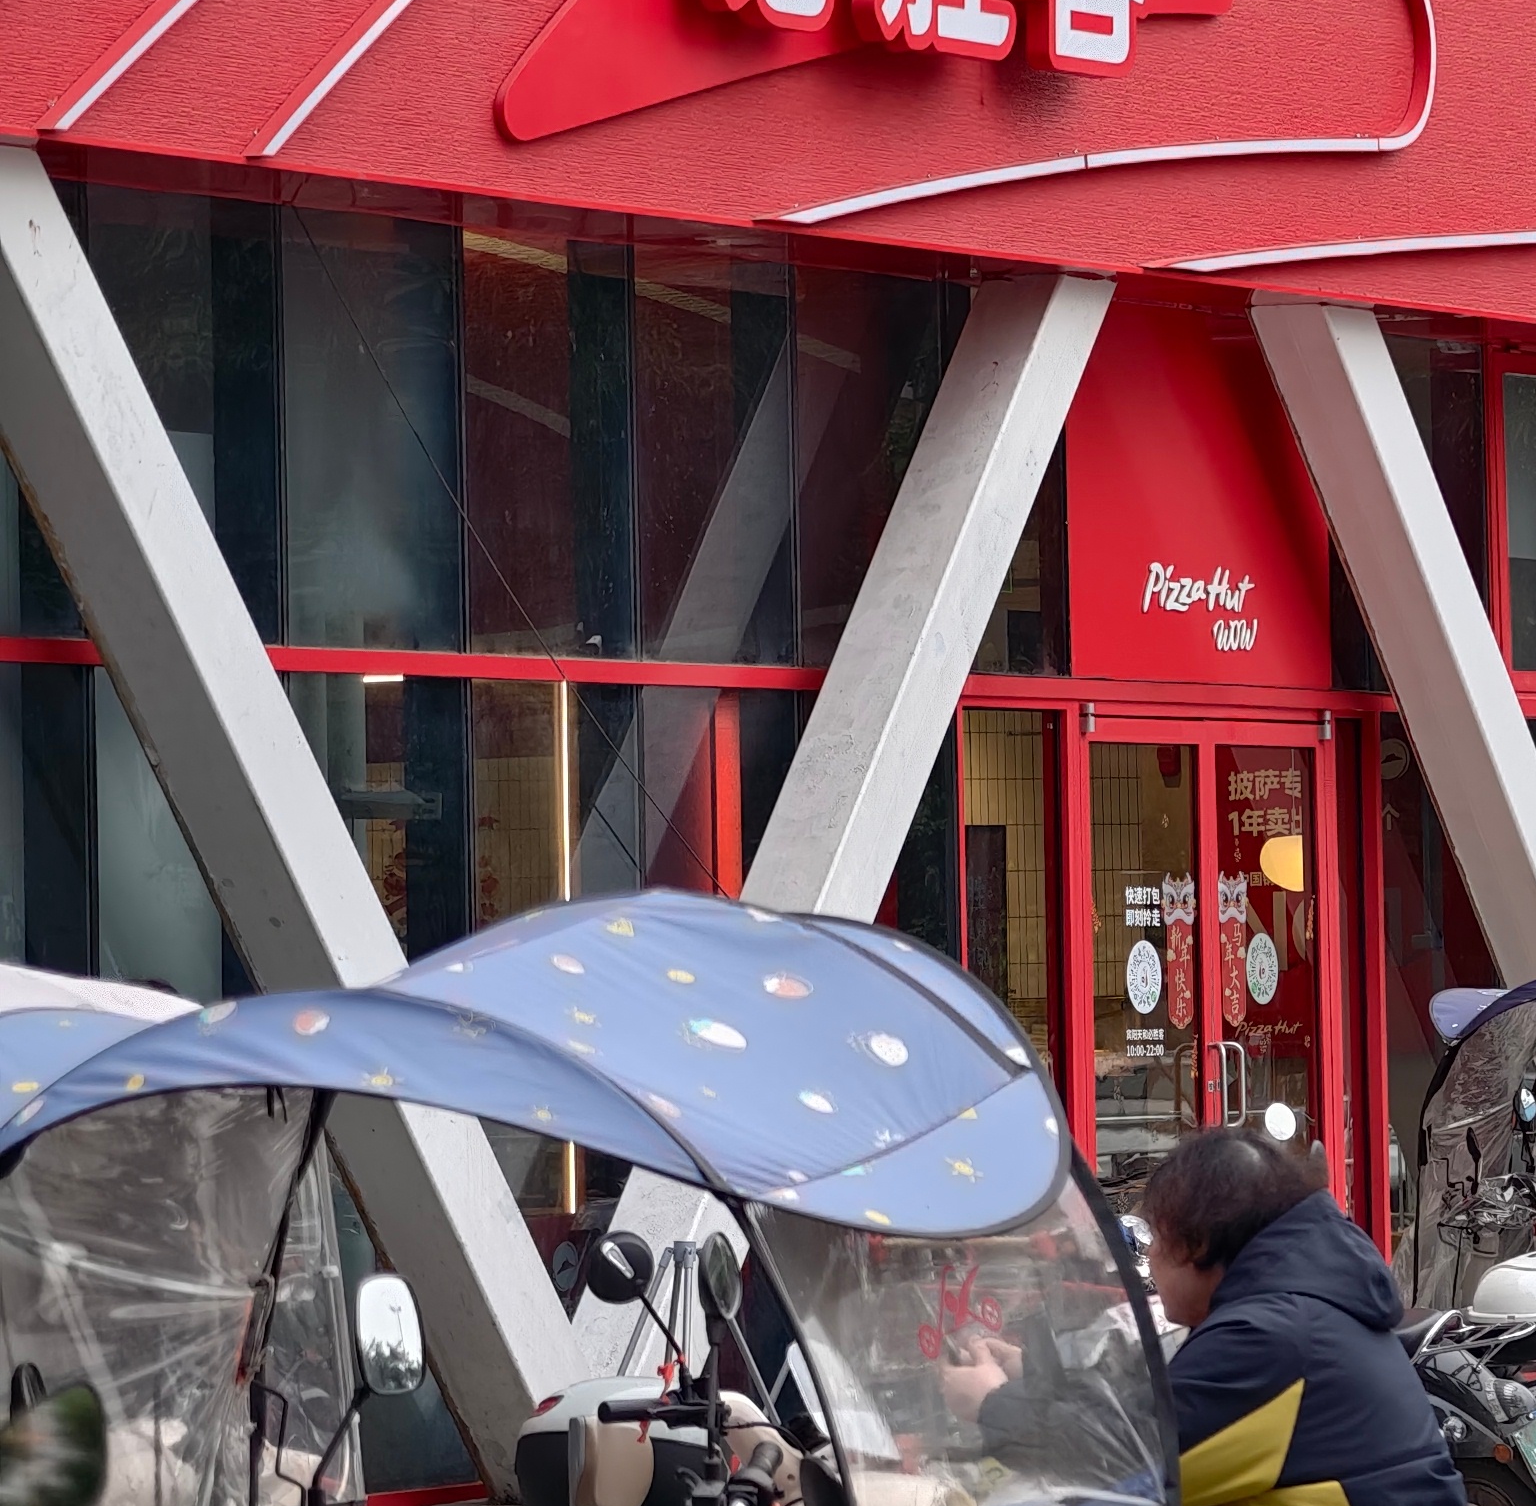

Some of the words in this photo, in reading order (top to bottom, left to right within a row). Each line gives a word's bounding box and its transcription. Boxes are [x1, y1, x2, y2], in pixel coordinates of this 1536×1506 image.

[1142, 561, 1207, 613] Pizza
[1206, 566, 1256, 613] Hut
[1125, 886, 1161, 906] 快速打包
[1125, 908, 1161, 928] 即刻拎走
[1169, 924, 1191, 1018] 新年快乐
[1223, 922, 1243, 1015] 马年大吉
[1234, 1021, 1273, 1038] Pizza
[1273, 1019, 1303, 1036] Hut
[1126, 1045, 1165, 1057] 10:00-22:00
